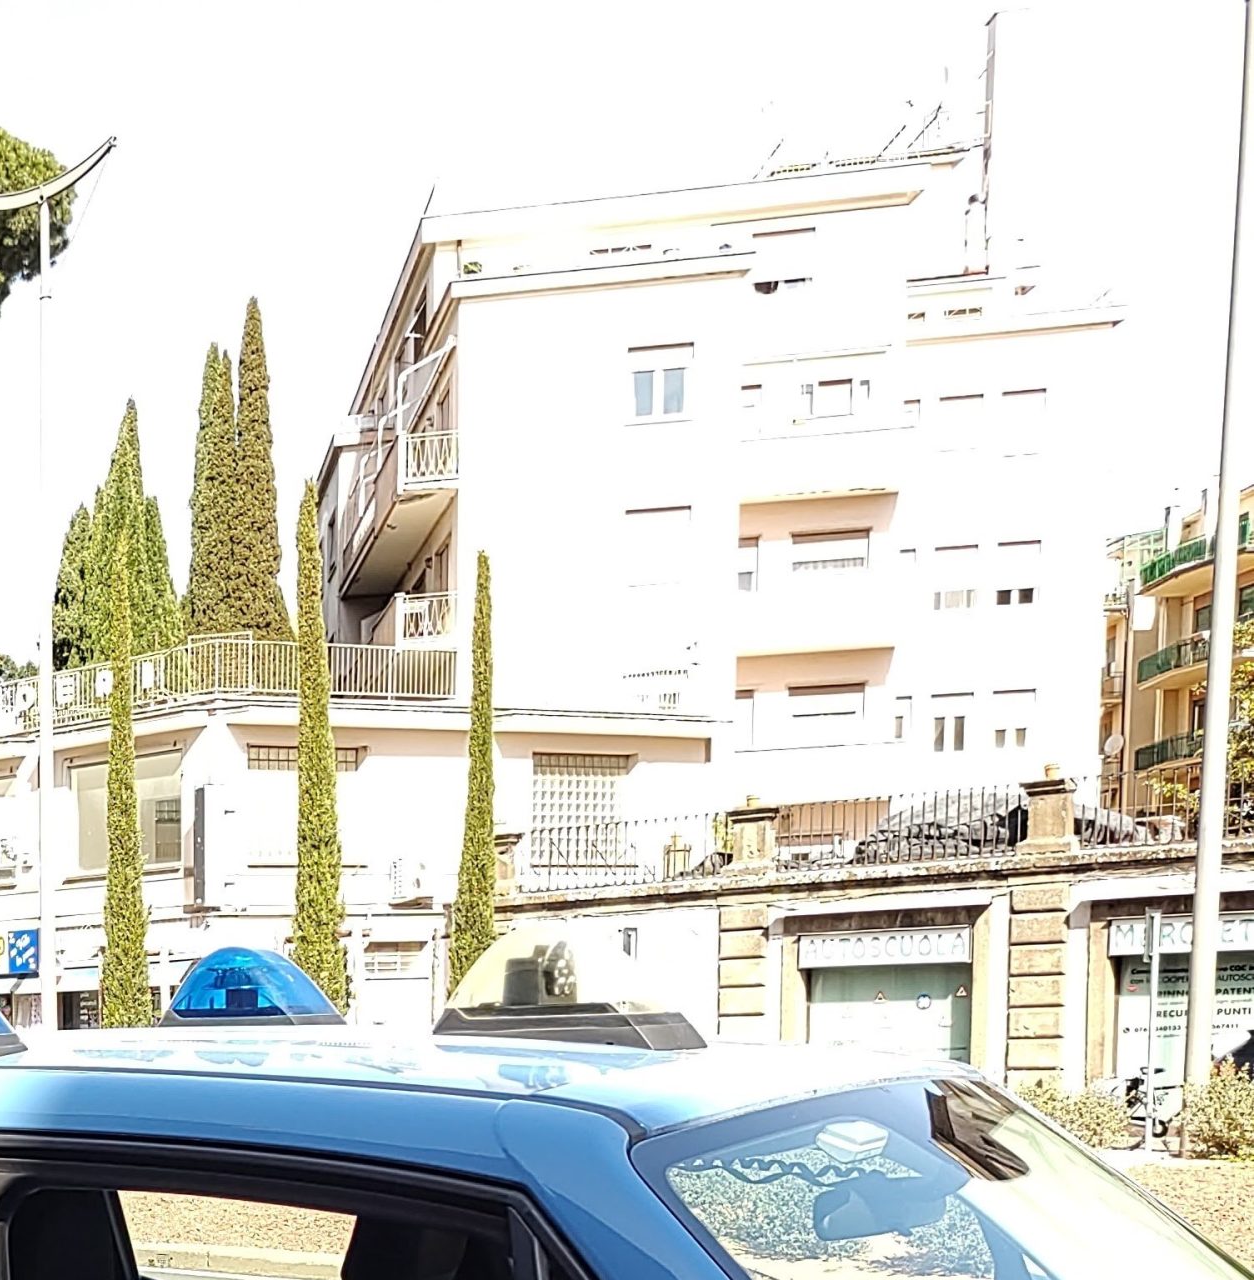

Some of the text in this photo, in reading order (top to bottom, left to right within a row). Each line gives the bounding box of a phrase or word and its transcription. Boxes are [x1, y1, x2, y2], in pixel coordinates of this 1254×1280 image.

[804, 932, 966, 959] AUTOSCUOLA
[1115, 918, 1254, 948] MRCET
[1216, 1007, 1252, 1016] PUNTI
